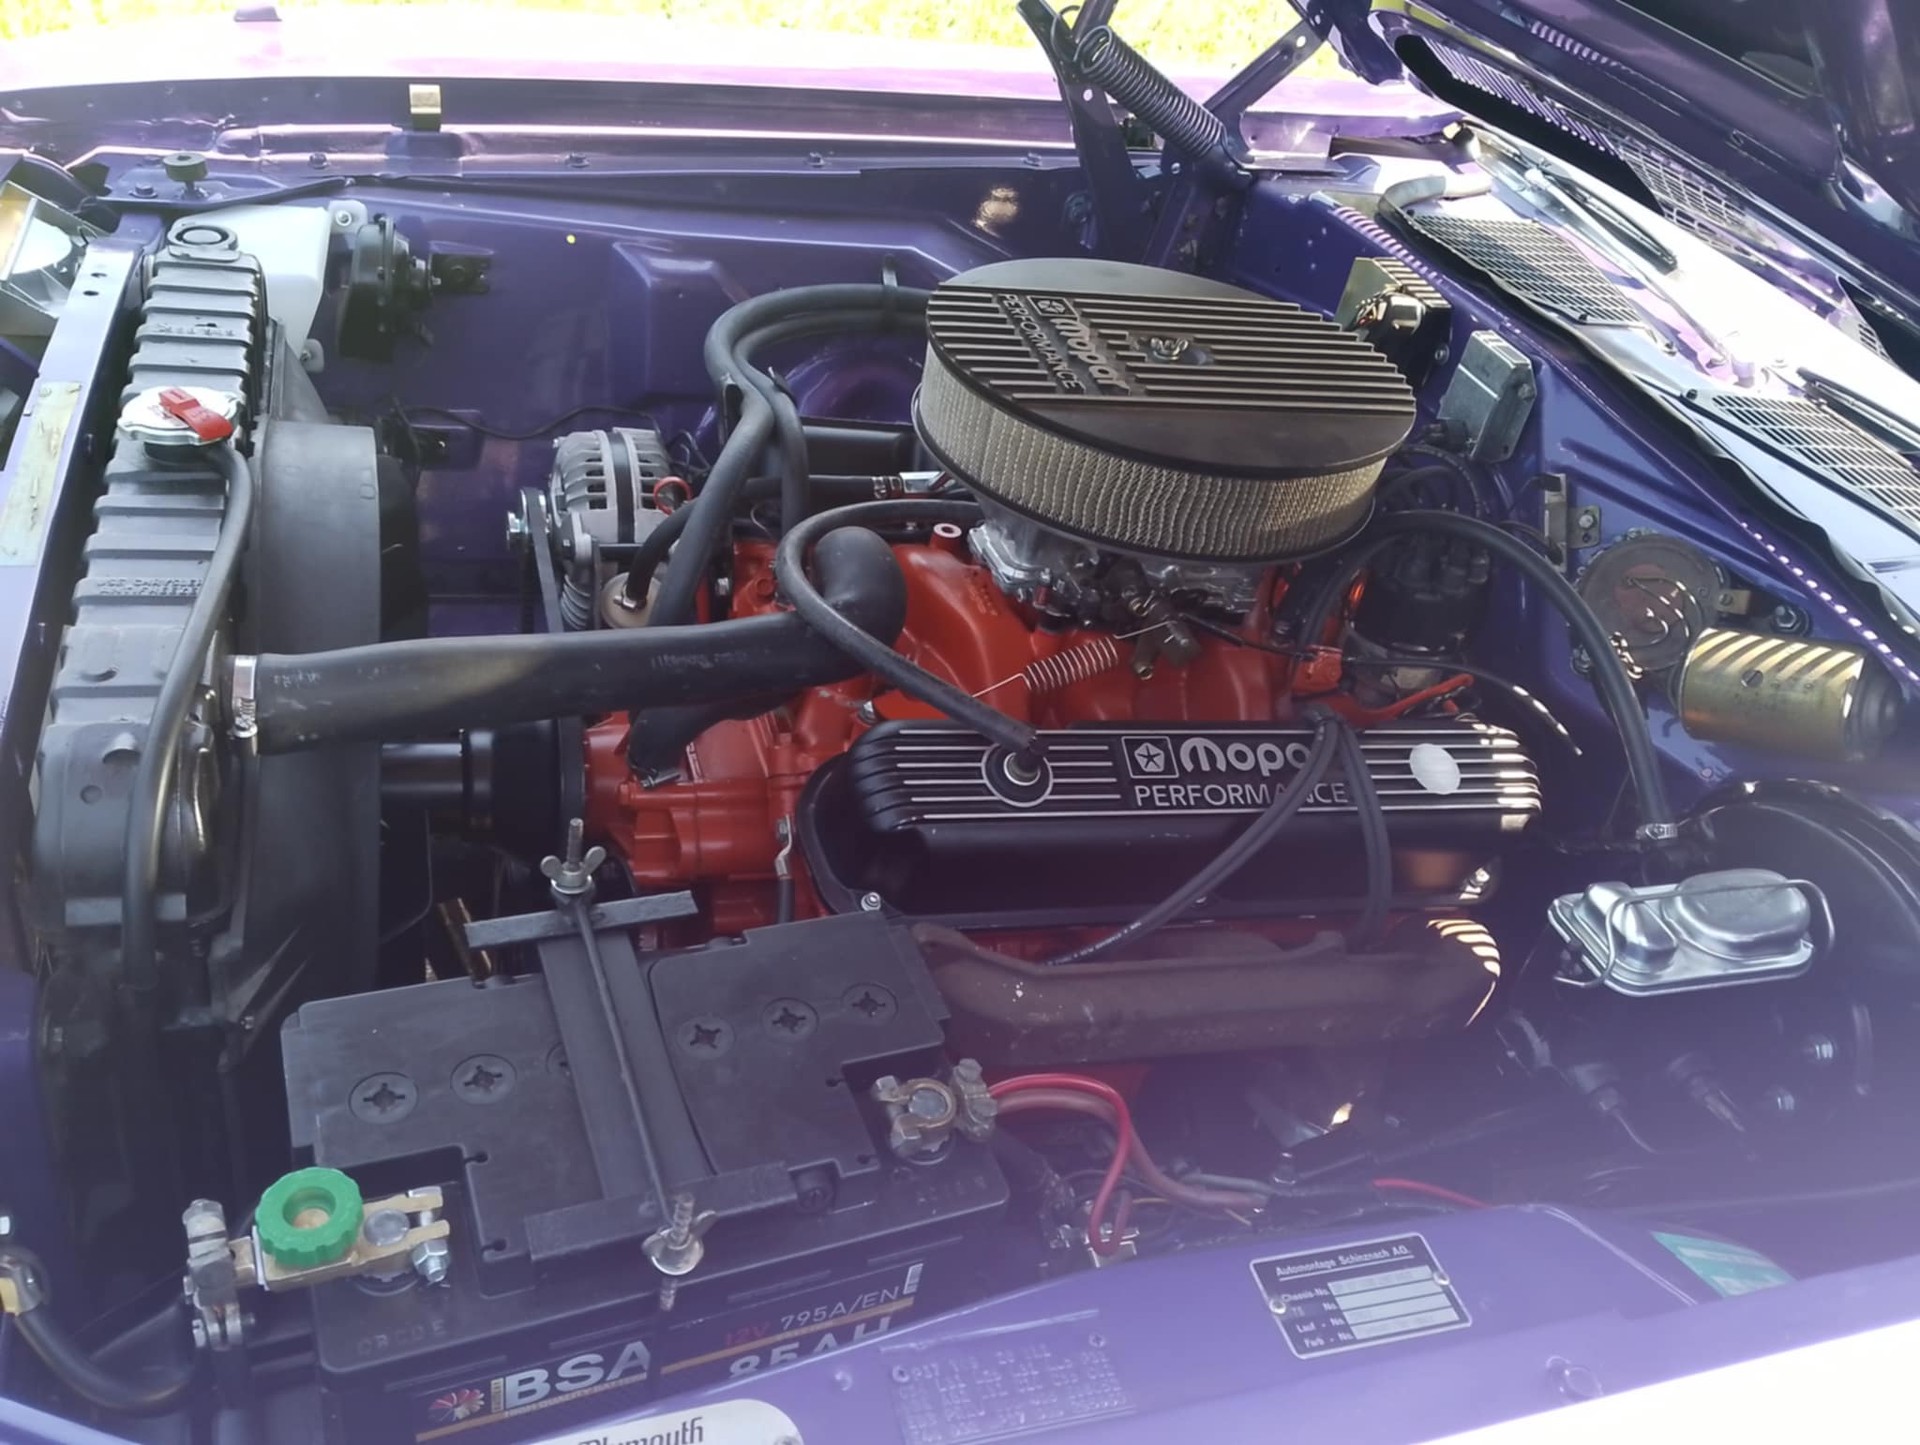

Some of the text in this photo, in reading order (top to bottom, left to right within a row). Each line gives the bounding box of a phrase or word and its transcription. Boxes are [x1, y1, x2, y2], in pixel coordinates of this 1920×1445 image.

[998, 293, 1087, 392] PERFORMANCE
[1179, 737, 1314, 777] Mopa
[1134, 783, 1348, 807] PERFORMCE
[780, 1285, 900, 1331] 795A/EN
[505, 1340, 651, 1410] BSA
[578, 1415, 704, 1445] outh
